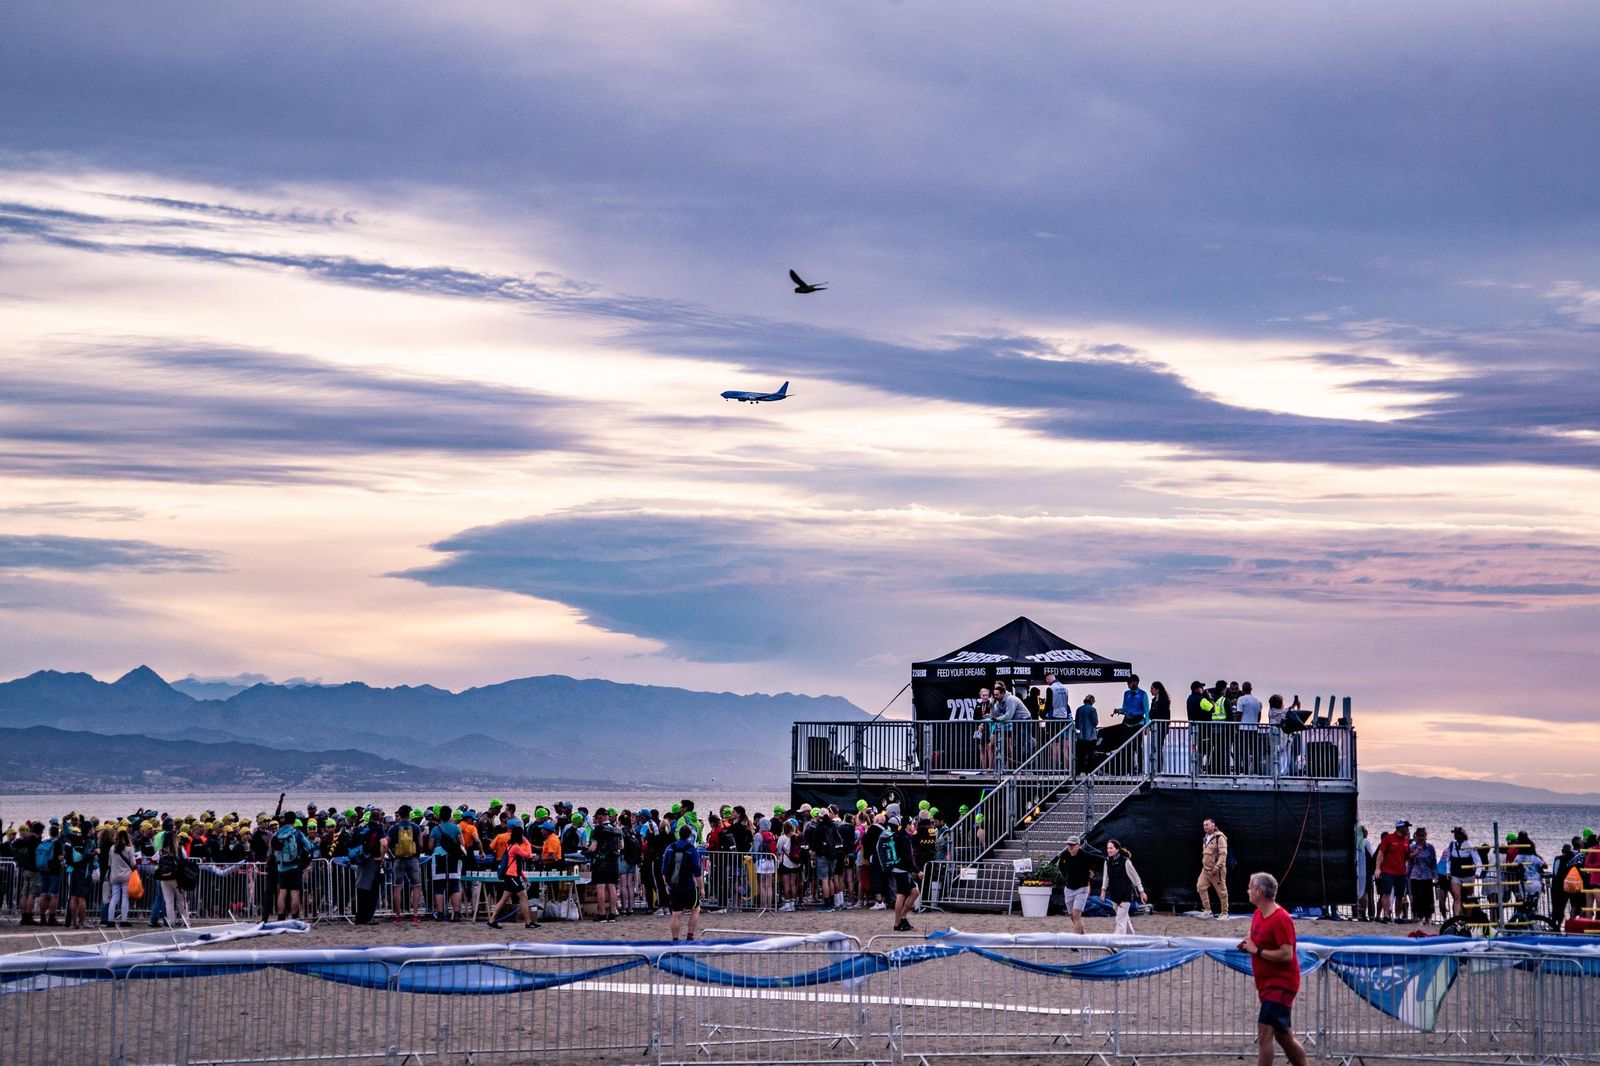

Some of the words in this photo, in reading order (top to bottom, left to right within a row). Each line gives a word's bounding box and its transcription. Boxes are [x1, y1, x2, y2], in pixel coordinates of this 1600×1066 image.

[1025, 649, 1093, 662] 226ERS
[912, 669, 927, 677] 226ERS
[937, 668, 949, 677] FEED
[950, 668, 964, 677] YOUR
[965, 667, 986, 676] DREAMS
[996, 667, 1011, 675] 226ERS
[1013, 666, 1031, 675] 226ERS
[1043, 667, 1058, 676] FEED
[1059, 667, 1075, 676] YOUR
[1076, 668, 1101, 677] DREAMS
[1113, 668, 1131, 677] 226ERS
